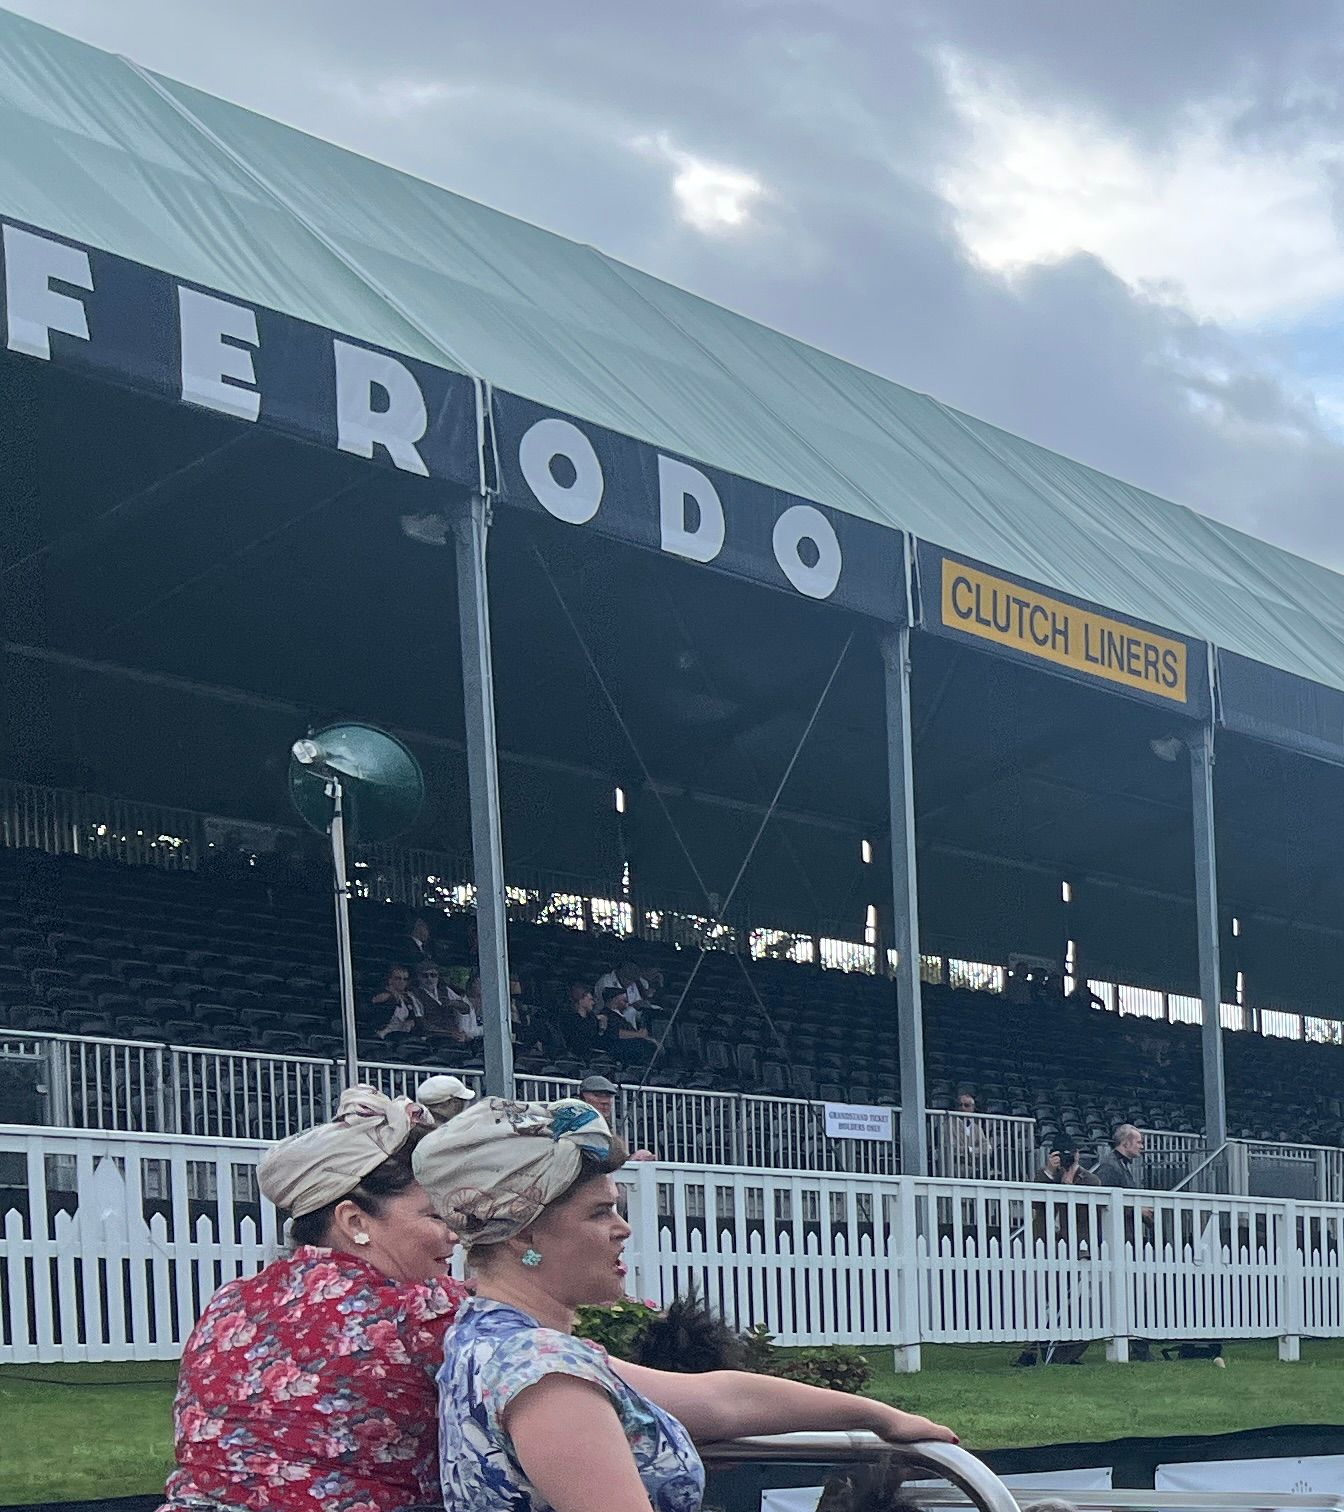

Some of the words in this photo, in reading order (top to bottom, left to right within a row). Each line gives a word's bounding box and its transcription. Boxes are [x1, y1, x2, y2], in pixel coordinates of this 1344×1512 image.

[2, 222, 842, 600] FERODO
[952, 576, 1069, 655] CLUTCH
[1084, 623, 1178, 688] LINERS
